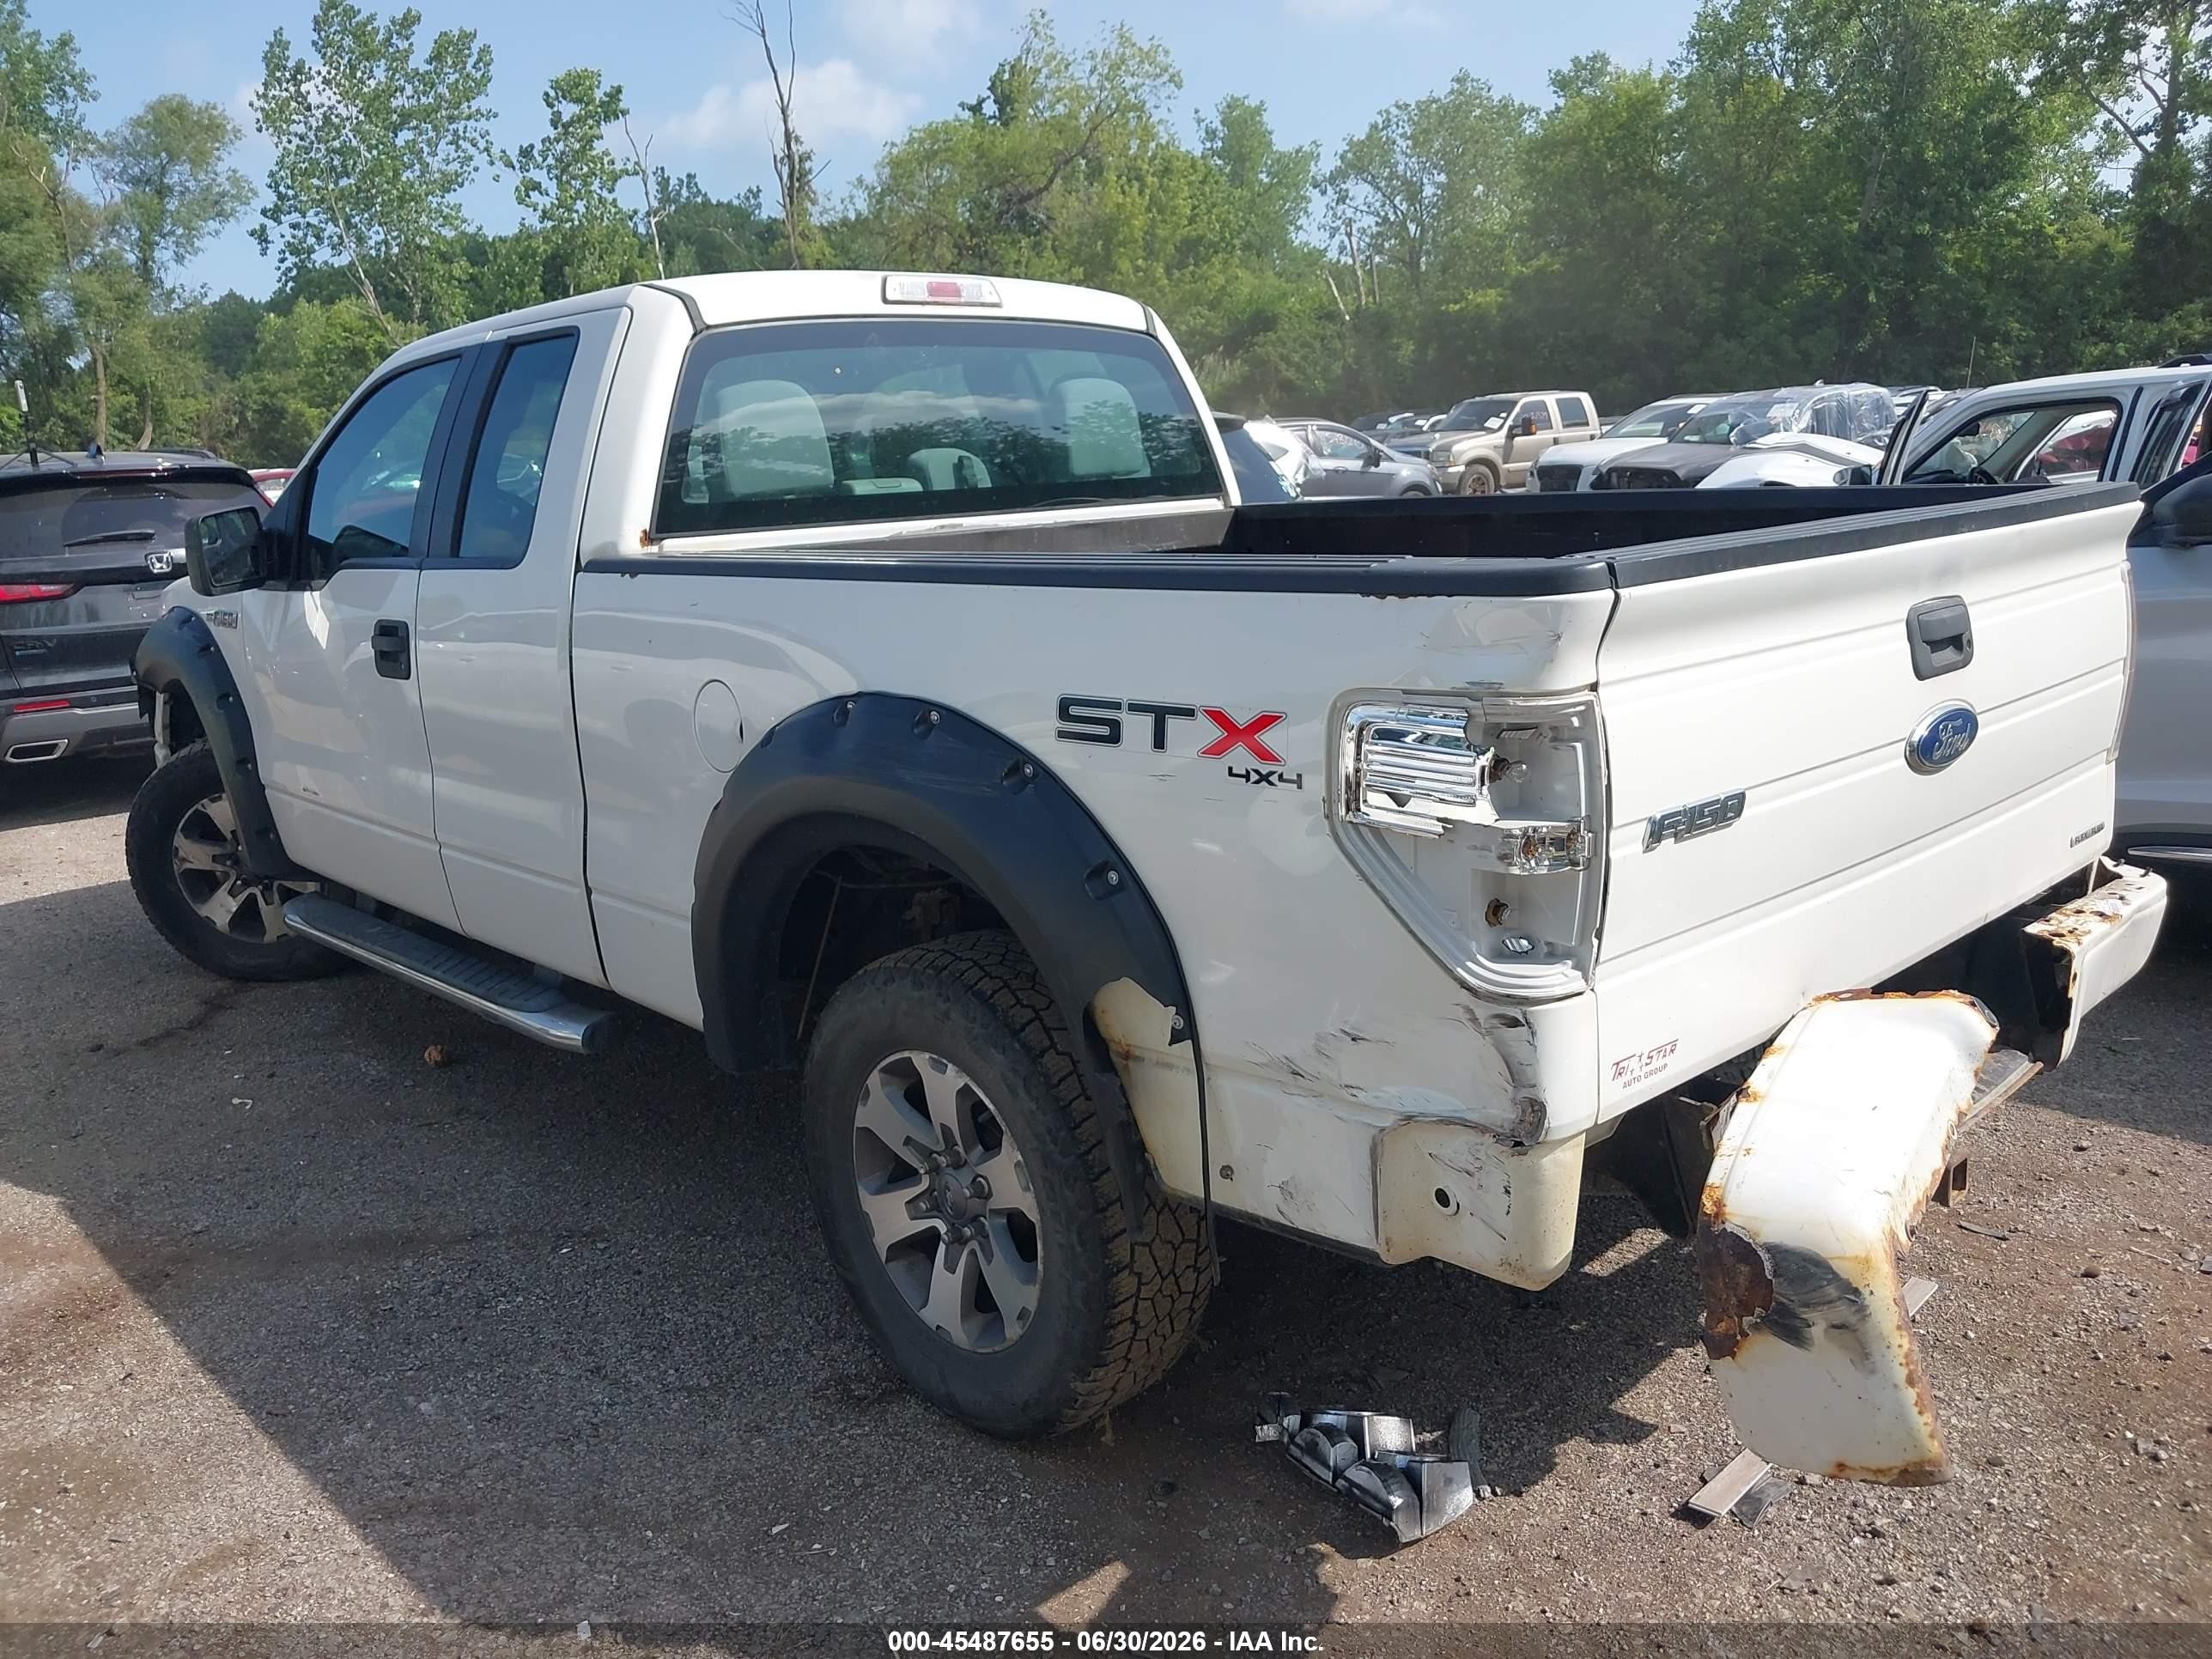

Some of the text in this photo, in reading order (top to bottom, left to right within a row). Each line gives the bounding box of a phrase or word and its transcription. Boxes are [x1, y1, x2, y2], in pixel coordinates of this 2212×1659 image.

[1055, 694, 1287, 766] STX
[1932, 718, 1972, 760] Ford
[1643, 789, 1746, 853] F-150
[1645, 1038, 1679, 1066] STAR
[1622, 1063, 1668, 1090] AUTO GROUP
